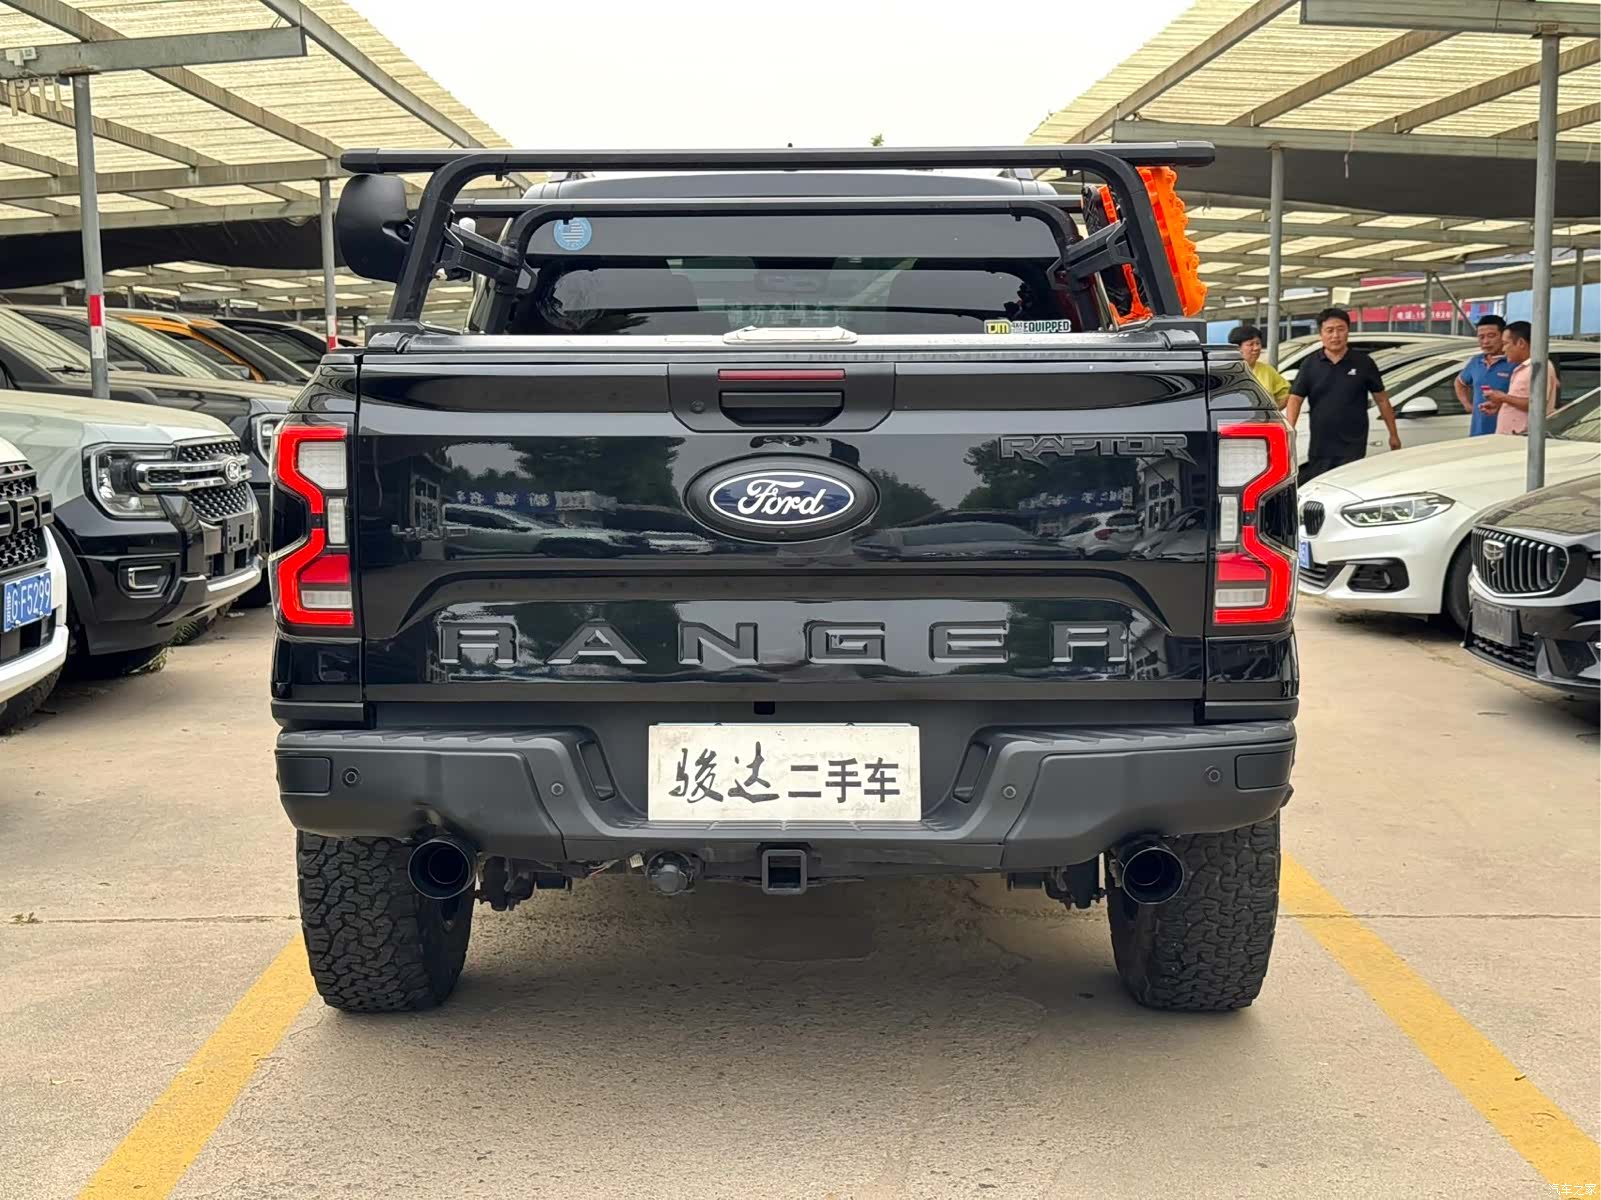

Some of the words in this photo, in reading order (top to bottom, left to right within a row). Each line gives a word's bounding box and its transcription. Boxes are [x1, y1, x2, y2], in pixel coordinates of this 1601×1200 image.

[1024, 320, 1070, 333] EQUIPPED
[999, 433, 1196, 467] RAPTOR
[735, 477, 826, 517] Ford
[438, 619, 1130, 667] RANGER
